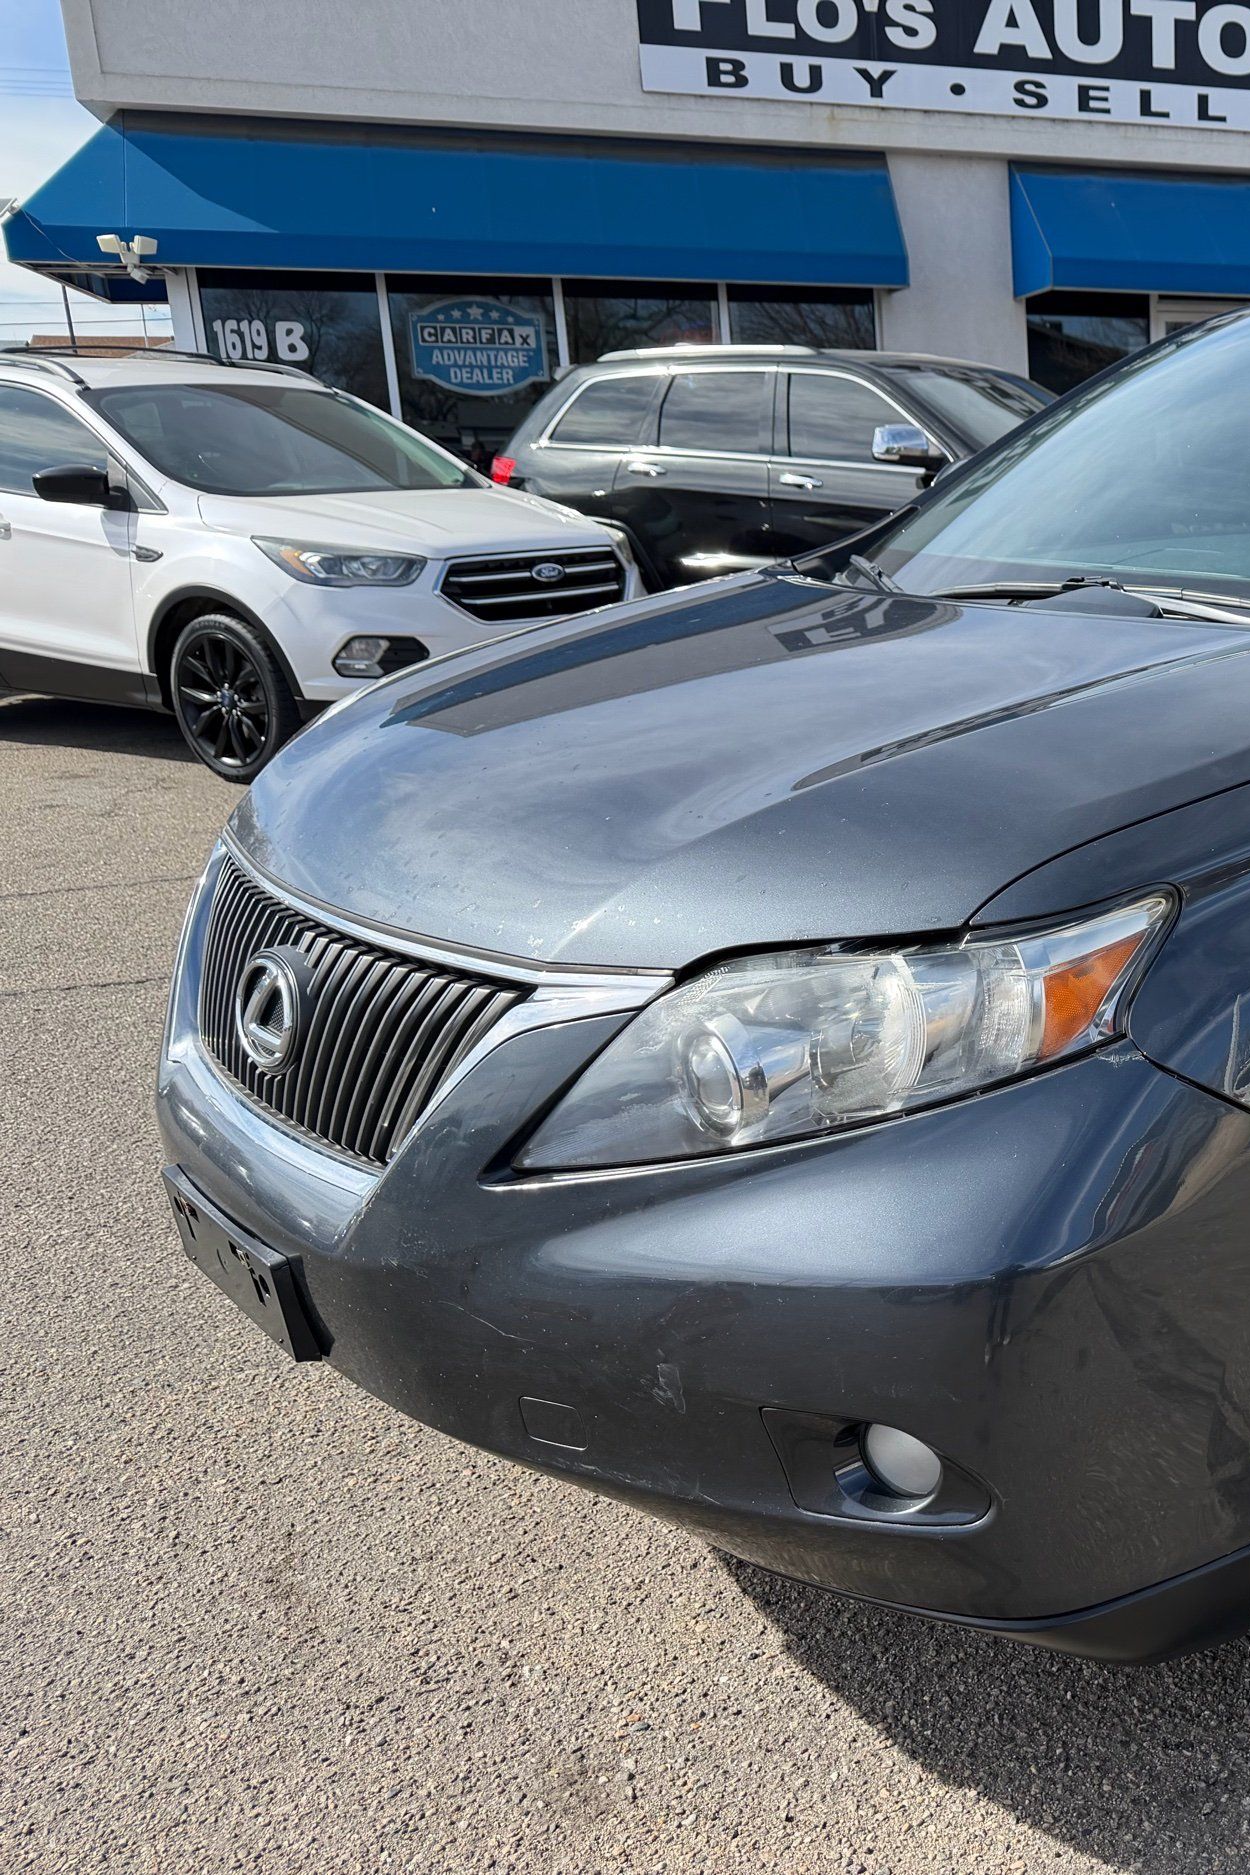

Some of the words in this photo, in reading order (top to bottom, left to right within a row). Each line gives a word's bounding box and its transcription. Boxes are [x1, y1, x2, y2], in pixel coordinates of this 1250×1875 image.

[706, 56, 898, 99] BUY
[1012, 79, 1228, 124] SELL
[212, 318, 269, 362] 1619
[276, 320, 311, 362] B
[421, 325, 533, 348] CARFAX
[431, 349, 529, 368] ADVANTAGE
[450, 366, 514, 385] DEALER
